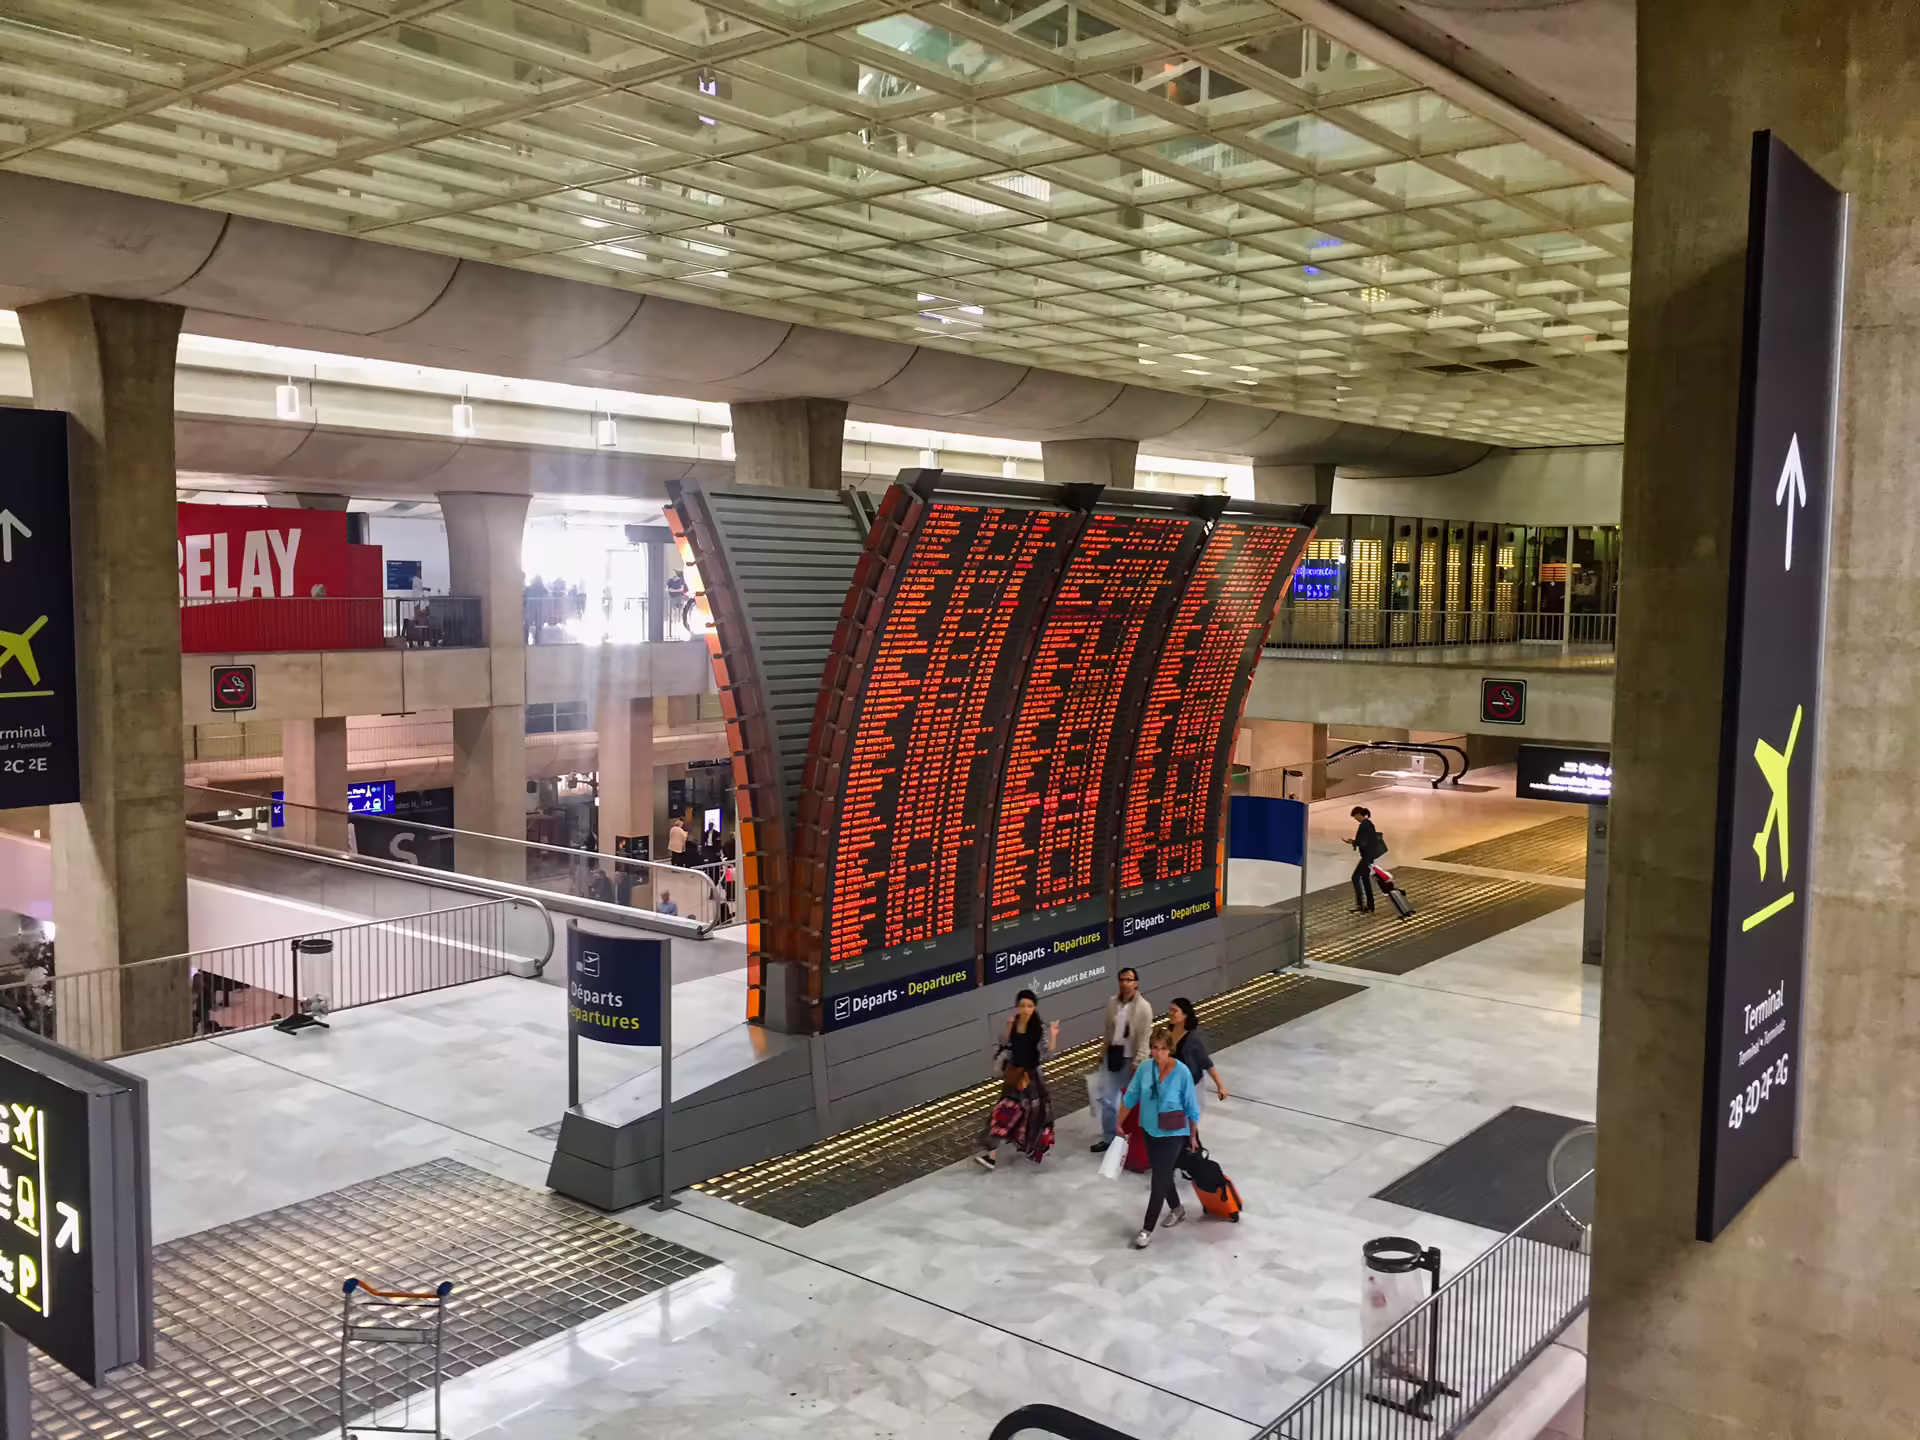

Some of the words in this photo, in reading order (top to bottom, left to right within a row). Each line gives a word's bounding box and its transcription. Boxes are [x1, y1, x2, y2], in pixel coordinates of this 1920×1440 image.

[177, 528, 301, 608] ELAY
[4, 760, 25, 774] 2C
[28, 757, 48, 771] 2E
[1134, 913, 1165, 930] Départs
[1171, 901, 1211, 920] Departures
[1009, 947, 1046, 966] Départs
[1053, 932, 1101, 953] Departures
[571, 981, 623, 1007] Départs
[852, 989, 898, 1011] Départs
[908, 970, 967, 996] Departures
[1043, 973, 1079, 992] AÉROPORTS
[1079, 970, 1088, 980] DE
[1088, 965, 1106, 978] PARIS
[1744, 979, 1784, 1035] Terminal
[1728, 1093, 1743, 1129] 2B
[1745, 1079, 1761, 1115] 2D
[1760, 1065, 1774, 1100] 2F
[1775, 1053, 1789, 1085] 2G
